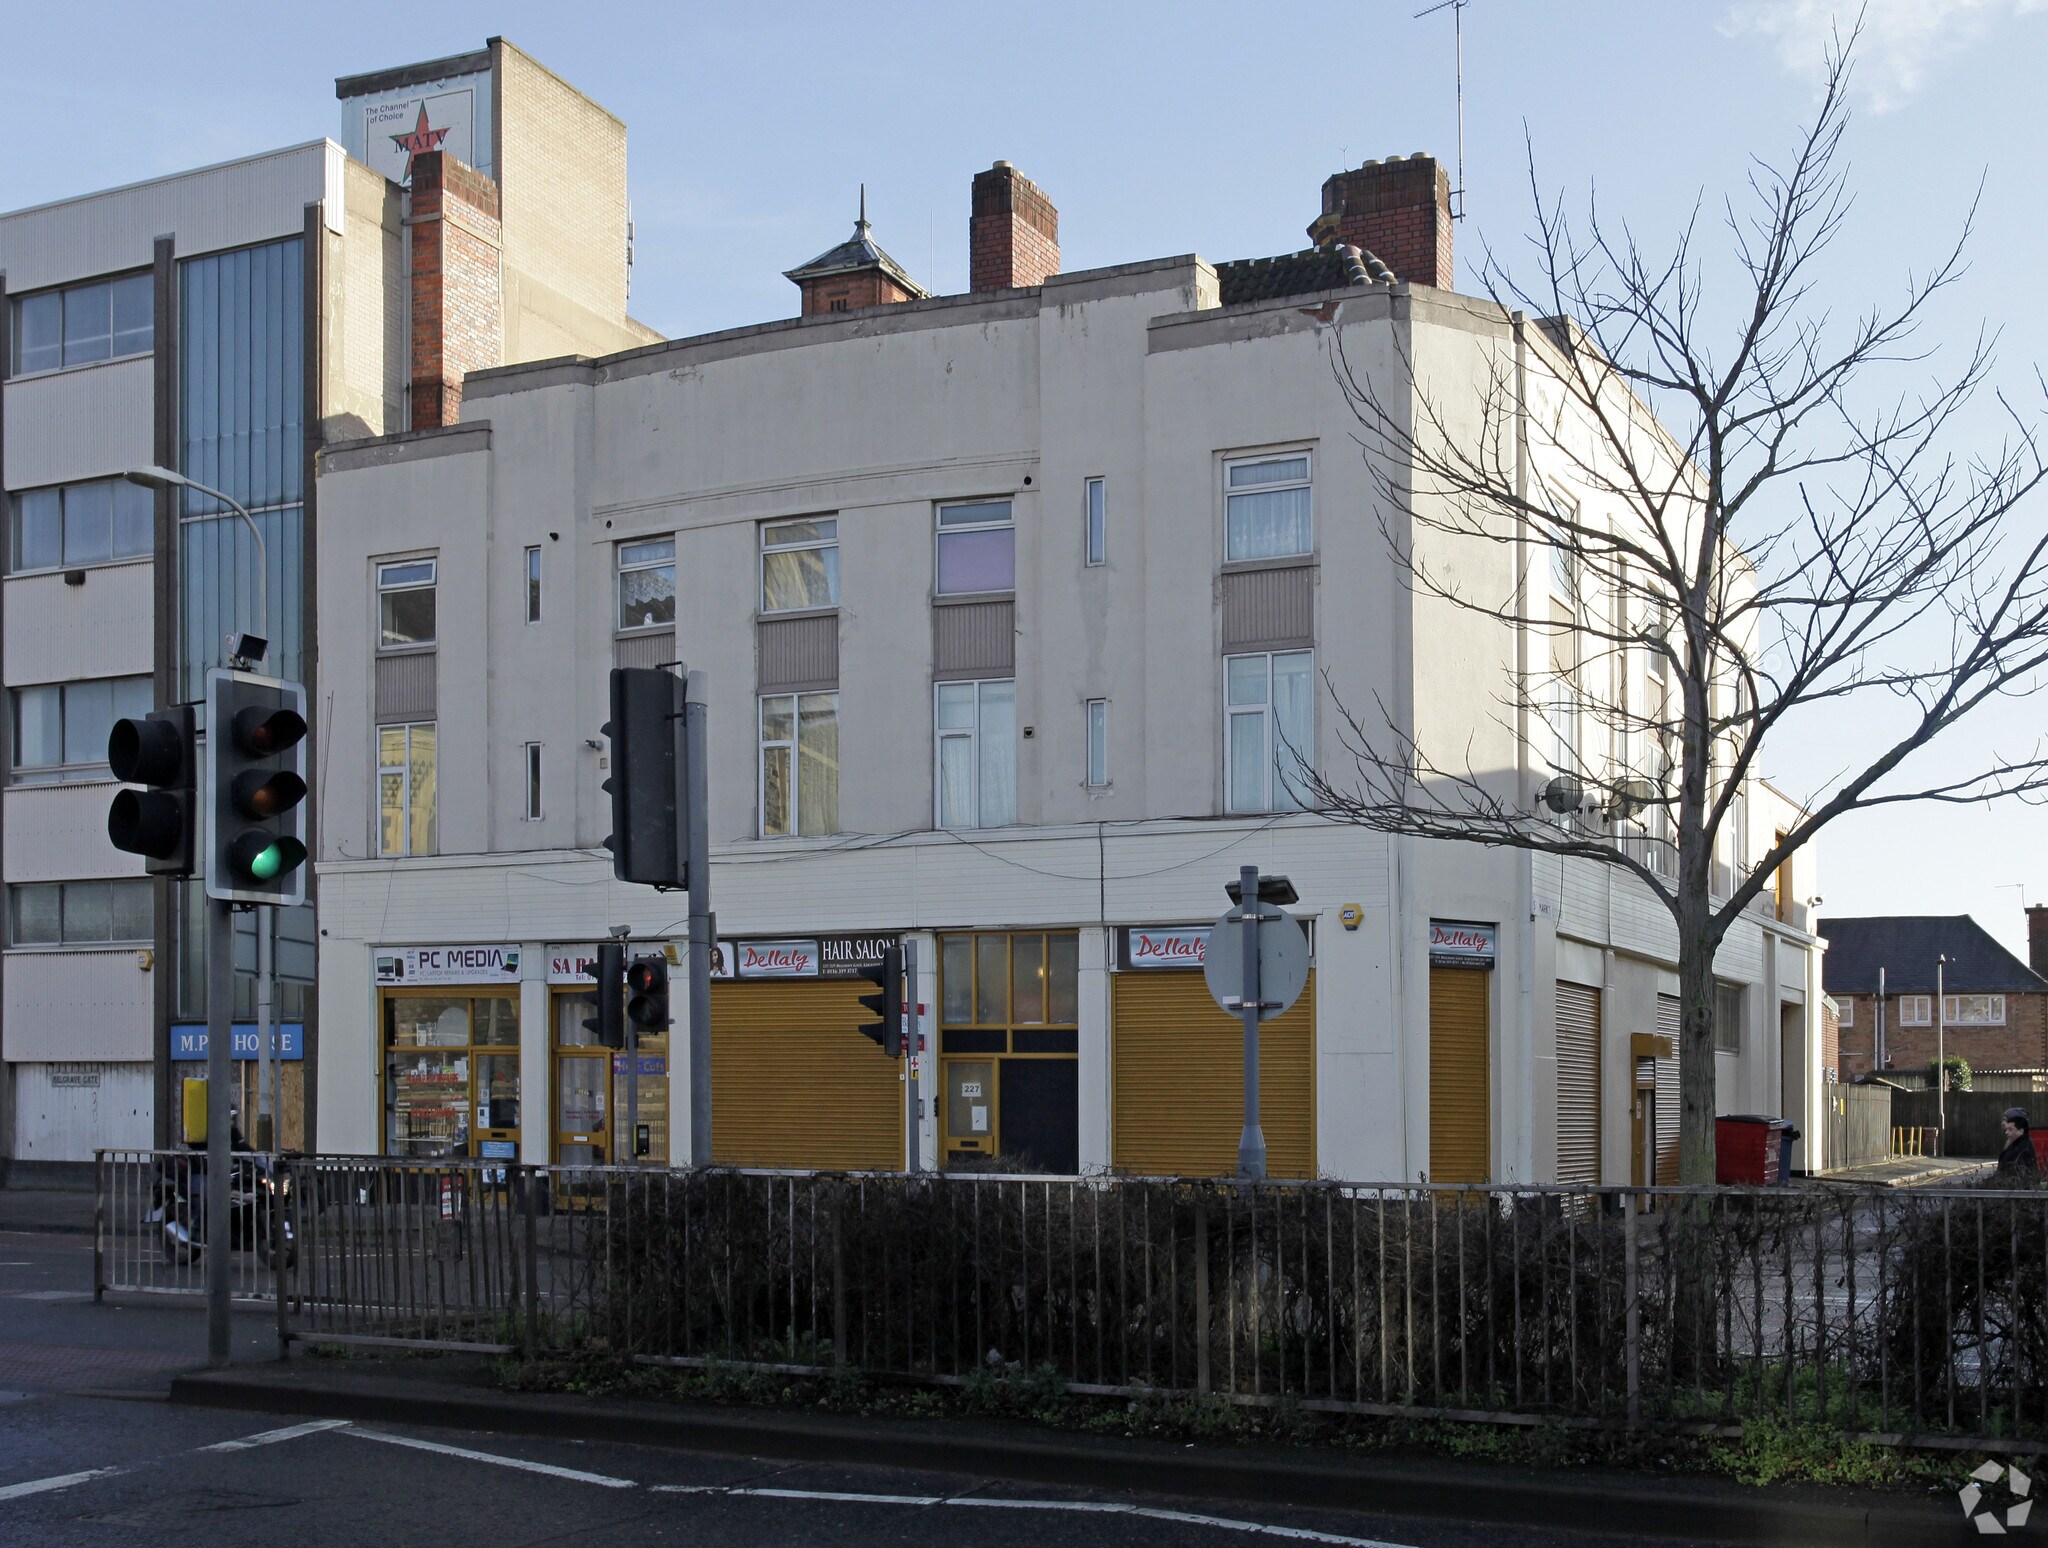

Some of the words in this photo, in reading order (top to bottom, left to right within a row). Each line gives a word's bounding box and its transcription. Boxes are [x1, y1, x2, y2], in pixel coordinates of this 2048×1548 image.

[365, 108, 378, 116] The
[380, 102, 410, 113] Channel
[370, 116, 378, 124] of
[379, 112, 404, 122] Choice
[394, 130, 447, 153] MATV
[1431, 927, 1488, 952] Dellaly
[822, 940, 854, 960] HAIR
[419, 951, 440, 969] PC
[447, 949, 503, 968] MEDIA
[552, 958, 571, 974] SA
[743, 947, 809, 972] Dellaly
[234, 1034, 292, 1051] HOE
[53, 1076, 81, 1084] BELGRAVE
[83, 1075, 98, 1084] GATE
[964, 1085, 979, 1093] 227
